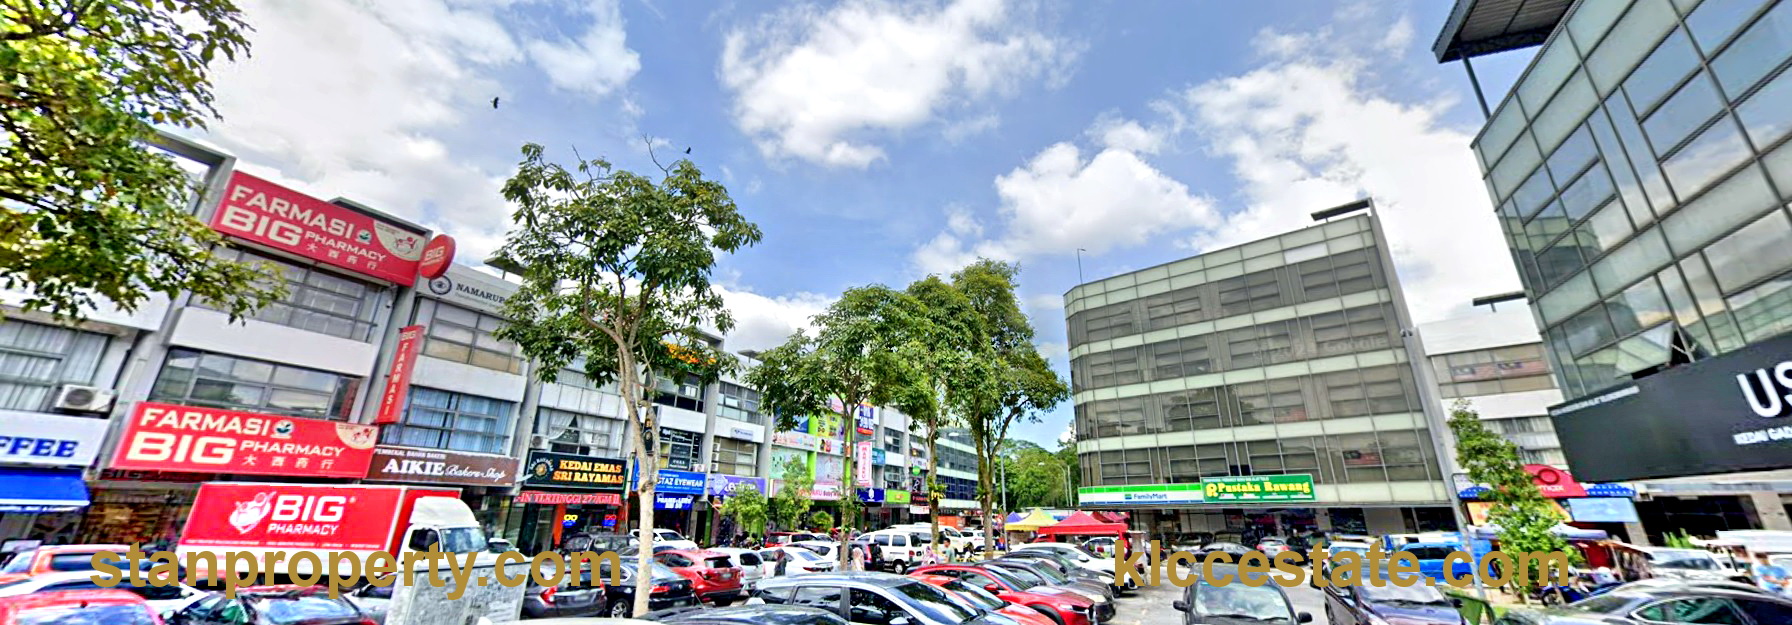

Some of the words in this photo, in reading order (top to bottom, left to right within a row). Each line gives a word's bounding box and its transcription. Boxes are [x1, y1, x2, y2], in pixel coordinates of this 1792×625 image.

[231, 184, 355, 239] FARMASI
[221, 205, 304, 247] BIG
[304, 230, 387, 262] PHARMACY
[140, 407, 271, 437] FARMASI
[126, 431, 238, 465] BIG
[239, 439, 345, 457] PHARMACY
[381, 458, 446, 476] AIKIE
[559, 460, 592, 472] KEDAI
[593, 462, 622, 474] EMAS
[552, 470, 573, 482] SRI
[573, 472, 624, 484] RAYAMAS
[674, 478, 704, 487] EYEWEAR
[1218, 482, 1261, 493] Pustaka
[1263, 481, 1311, 493] Rawang
[1133, 492, 1168, 501] FamilyMart
[271, 495, 347, 522] BIG
[267, 523, 339, 535] PHARMACY
